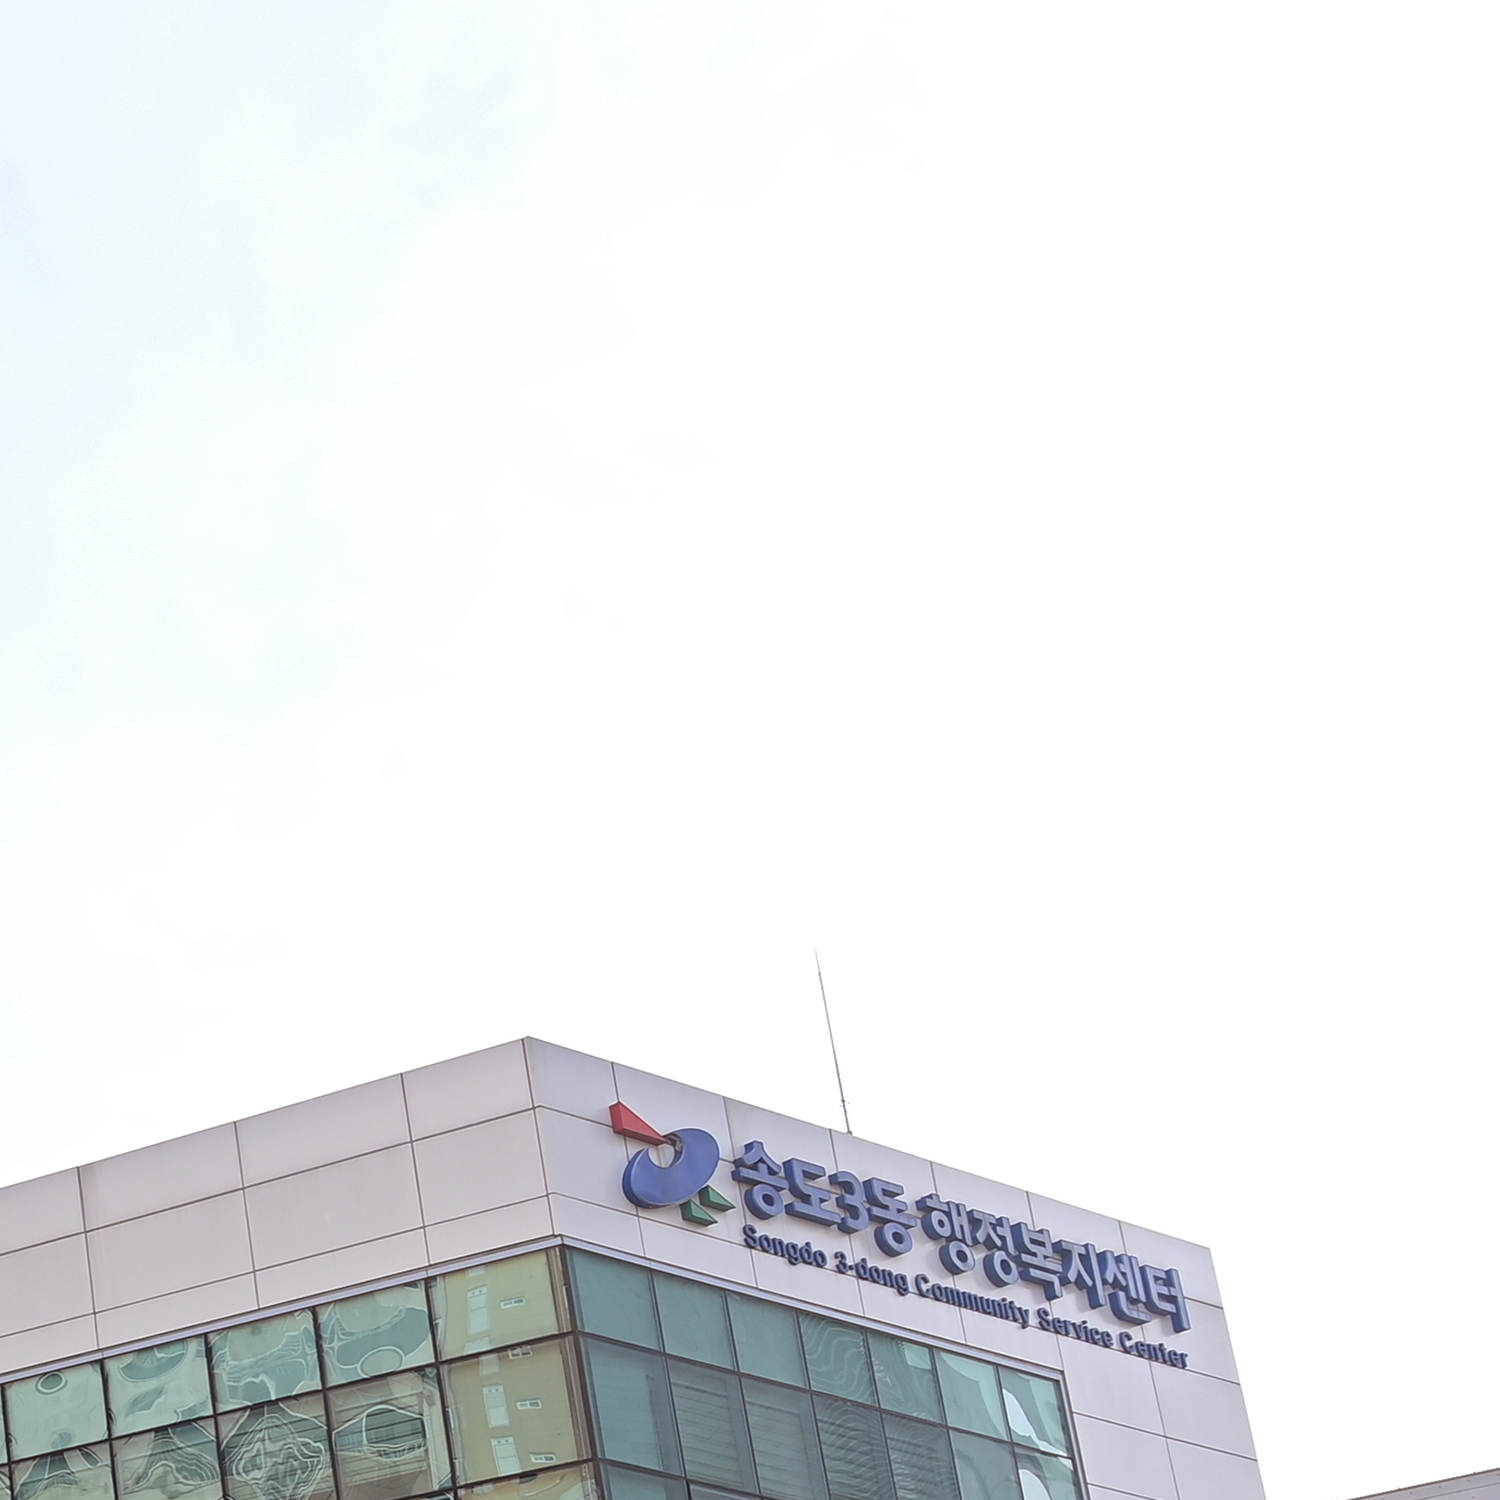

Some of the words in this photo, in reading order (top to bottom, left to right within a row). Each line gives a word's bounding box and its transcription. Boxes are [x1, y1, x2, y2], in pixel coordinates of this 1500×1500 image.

[732, 1140, 917, 1257] 송도3동
[916, 1193, 1192, 1335] 행정복지센터
[742, 1224, 828, 1268] Songdo
[834, 1250, 911, 1296] 3-dong
[914, 1273, 1030, 1329] Community
[1036, 1307, 1114, 1348] Service
[1119, 1331, 1189, 1369] Center
